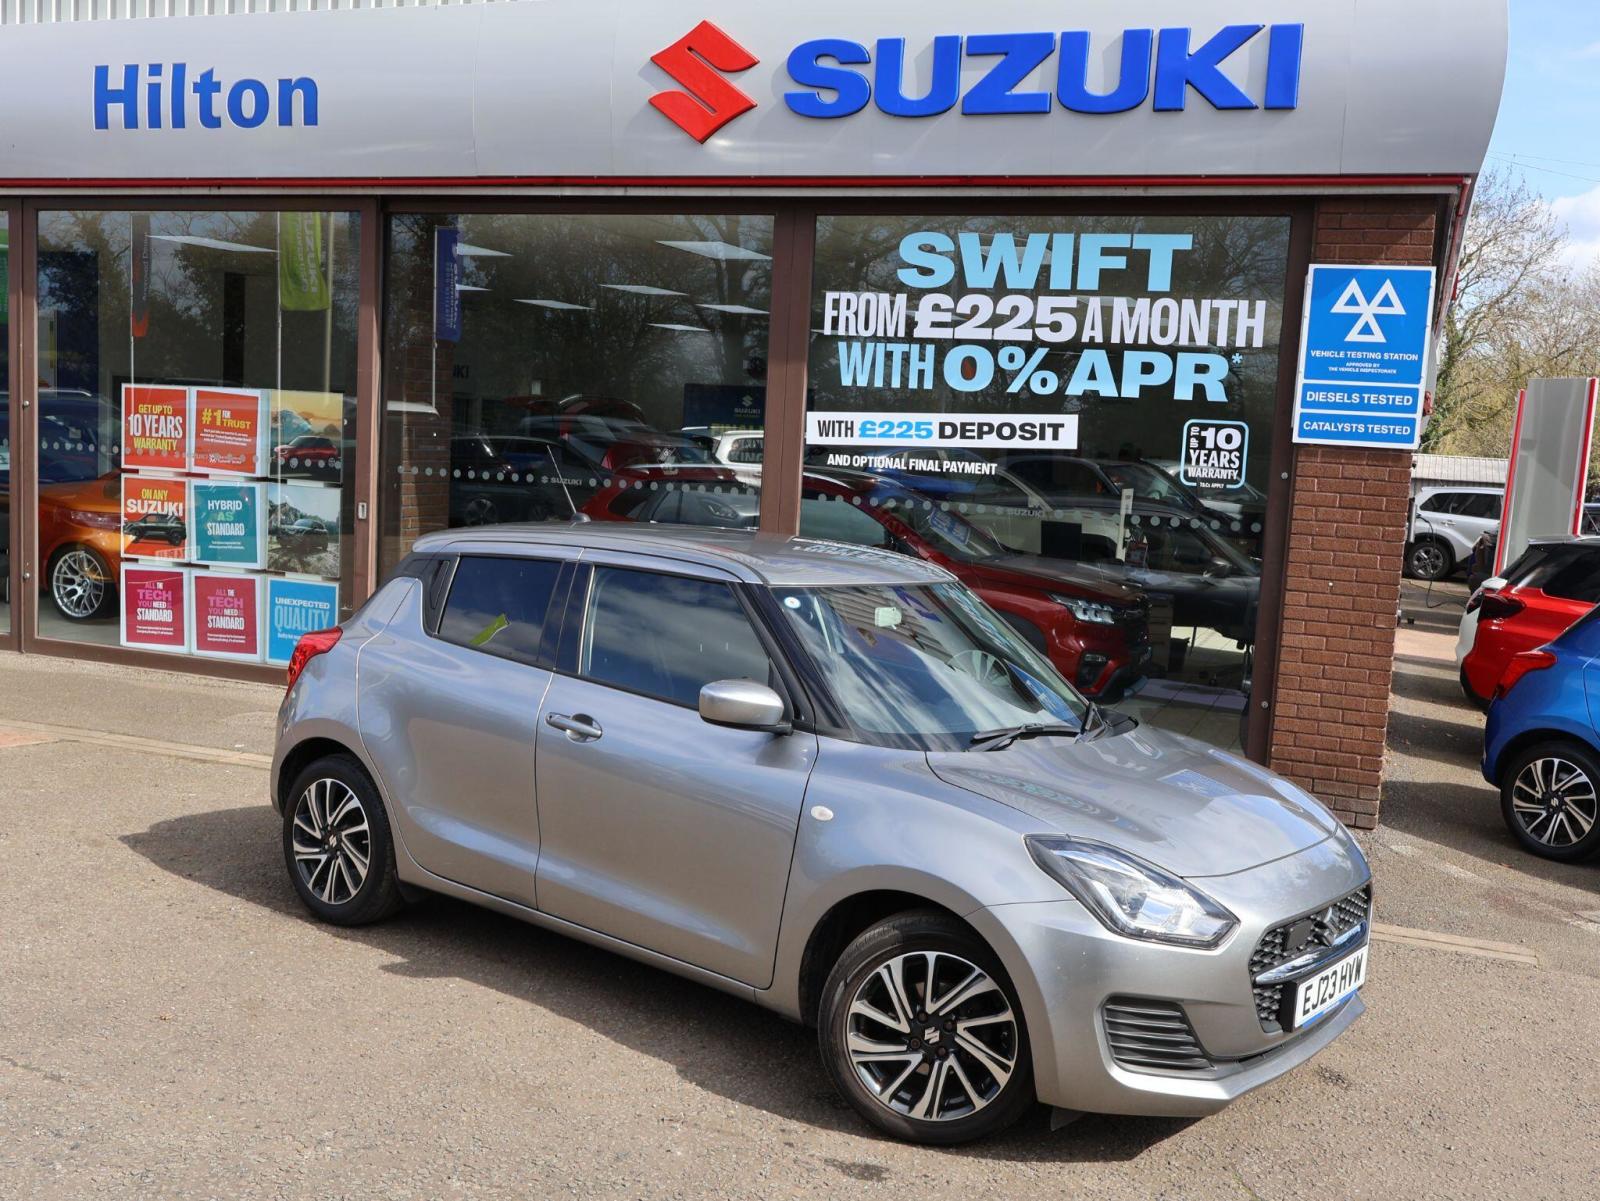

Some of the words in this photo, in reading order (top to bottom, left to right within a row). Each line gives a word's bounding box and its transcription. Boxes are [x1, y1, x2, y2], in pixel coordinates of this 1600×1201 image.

[785, 23, 1304, 118] SUZUKI
[93, 62, 319, 130] Hilton
[897, 231, 1193, 292] SWIFT
[823, 291, 908, 337] FROM
[913, 293, 1078, 343] £225
[1081, 296, 1104, 343] A
[1110, 297, 1267, 348] MONTH
[1310, 350, 1345, 358] VEHICLE
[1347, 351, 1381, 360] TESTING
[1383, 353, 1419, 361] STATION
[837, 341, 935, 390] WITH
[943, 344, 1059, 395] 0%
[1306, 391, 1361, 404] DIESELS
[1362, 393, 1413, 406] TESTED
[138, 404, 152, 413] GET
[152, 405, 163, 414] UP
[163, 406, 173, 415] TO
[202, 408, 222, 426] #1
[222, 418, 252, 430] TRUST
[128, 413, 142, 437] 10
[143, 414, 183, 439] YEARS
[817, 419, 854, 438] WITH
[858, 420, 933, 439] £225
[938, 421, 1065, 441] DEPOSIT
[1190, 426, 1200, 436] TO
[1303, 421, 1365, 433] CATALYSTS
[1366, 424, 1411, 435] TESTED
[133, 437, 178, 451] WARRANTY
[1189, 437, 1199, 448] UP
[1200, 427, 1242, 450] 10
[827, 453, 851, 467] AND
[852, 455, 907, 470] OPTIONAL
[909, 458, 941, 472] FINAL
[942, 460, 997, 475] PAYMENT
[1189, 449, 1240, 468] YEARS
[1187, 467, 1239, 480] WARRANTY
[551, 477, 582, 486] SUZUKI
[141, 488, 152, 500] ON
[153, 489, 168, 501] ANY
[126, 498, 184, 517] SUZUKI
[207, 500, 243, 511] HYBRID
[217, 511, 234, 521] AS
[207, 523, 245, 536] STANDARD
[137, 589, 172, 601] TECH
[207, 596, 244, 608] TECH
[138, 600, 153, 608] YOU
[275, 597, 330, 609] UNEXPECTED
[136, 608, 173, 622] STANDARD
[274, 606, 330, 632] QUALITY
[207, 616, 245, 630] STANDARD
[1302, 969, 1338, 1016] EJ23
